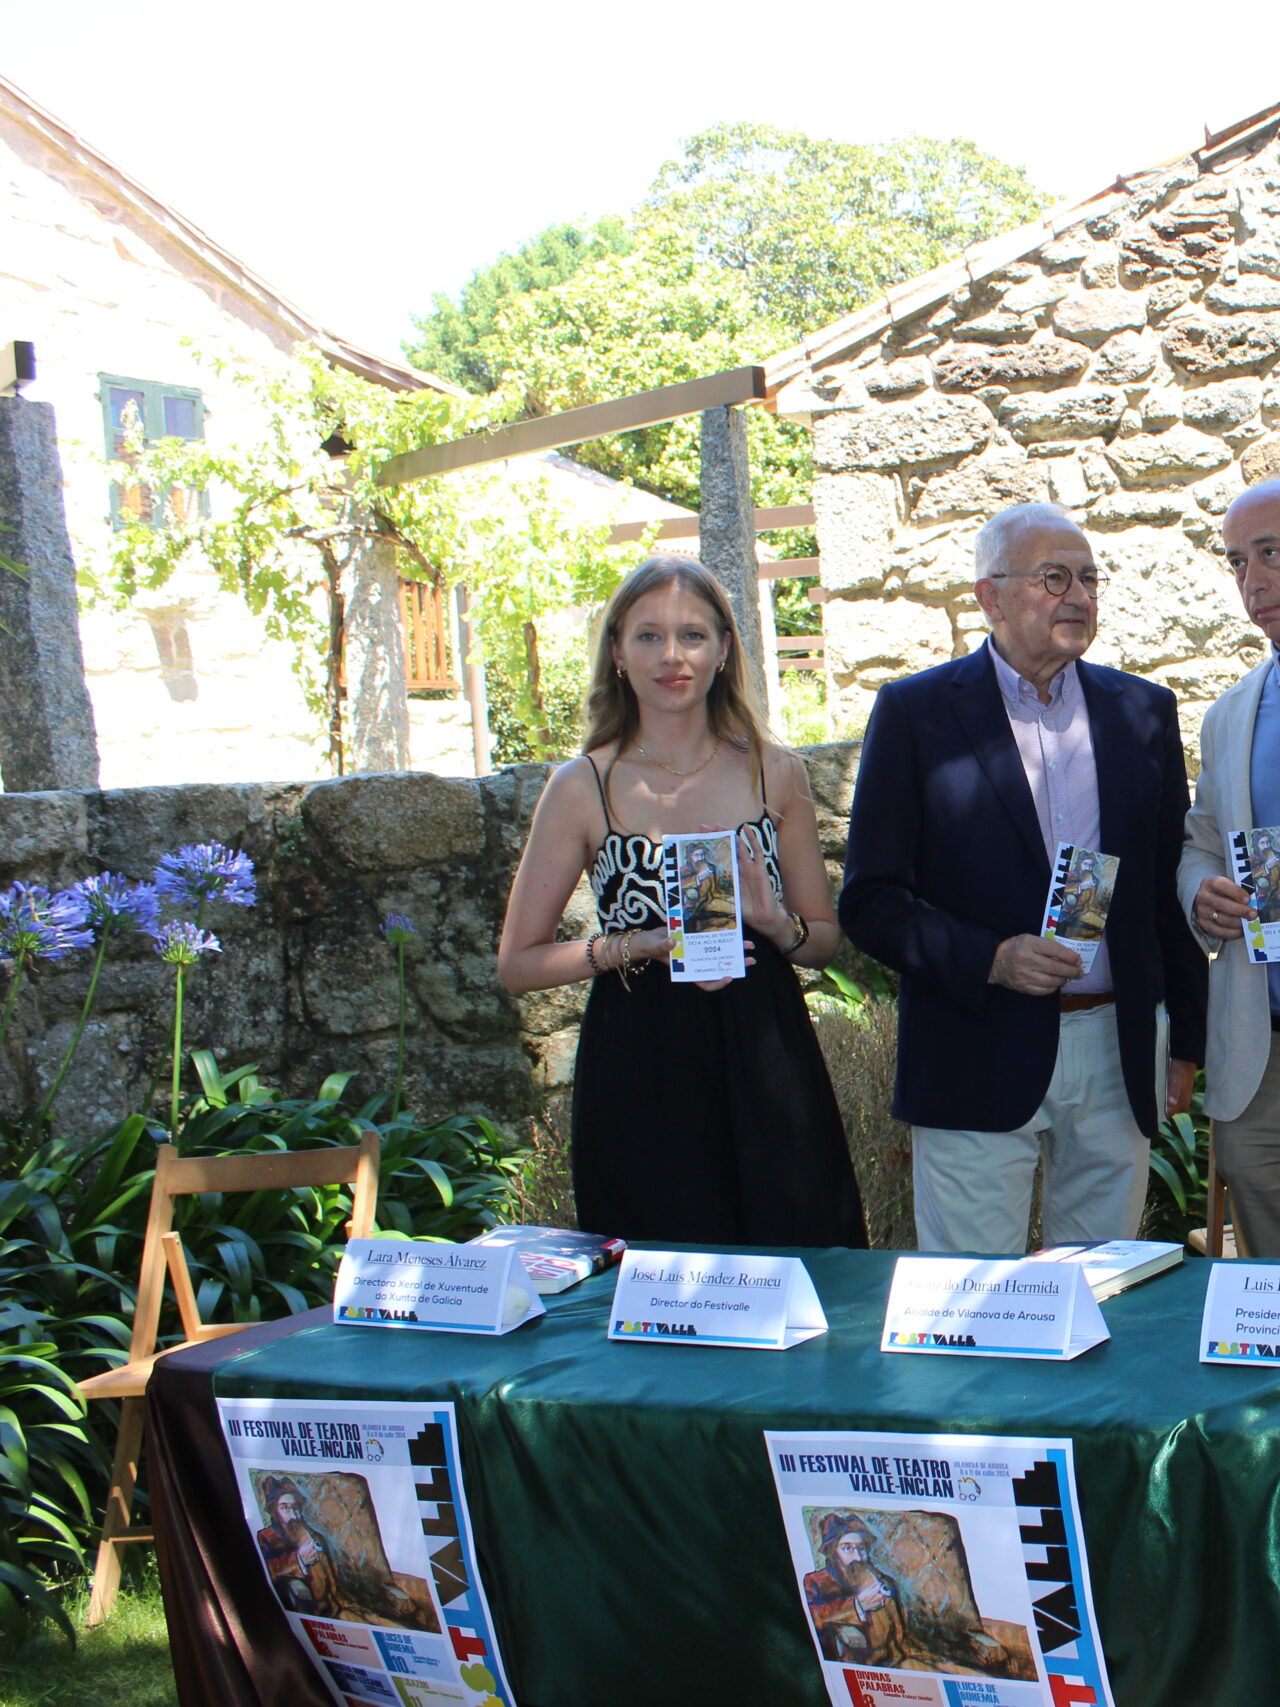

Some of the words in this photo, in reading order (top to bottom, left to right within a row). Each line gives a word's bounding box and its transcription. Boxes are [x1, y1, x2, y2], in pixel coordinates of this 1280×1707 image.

[1044, 845, 1074, 940] STIVALLE
[1233, 831, 1268, 961] FESIVALLE
[664, 842, 685, 973] FESTIVALLE
[704, 946, 721, 954] 2024
[367, 1249, 393, 1263] Lara
[394, 1251, 444, 1266] Meneses
[445, 1252, 487, 1269] Álvarez
[353, 1276, 396, 1288] Directora
[398, 1279, 423, 1290] Xeral
[425, 1281, 436, 1291] de
[438, 1282, 489, 1294] Xuventude
[630, 1267, 656, 1281] José
[687, 1270, 736, 1285] Méndez
[738, 1272, 782, 1288] Romeu
[1244, 1276, 1274, 1291] Luis
[962, 1278, 1001, 1293] Durán
[1004, 1279, 1060, 1294] Hermida
[375, 1291, 387, 1300] da
[390, 1292, 417, 1303] Xunta
[418, 1294, 430, 1303] de
[432, 1294, 463, 1305] Galicia
[650, 1297, 689, 1308] Director
[690, 1299, 703, 1309] do
[704, 1300, 750, 1312] Festivalle
[339, 1305, 419, 1322] FESTIVALLE
[904, 1306, 941, 1318] Alcalde
[942, 1308, 955, 1318] de
[957, 1308, 1001, 1320] Vilanova
[1002, 1310, 1016, 1320] de
[1017, 1311, 1056, 1322] Arousa
[615, 1320, 697, 1336] FESTIVALLE
[889, 1332, 976, 1347] FESTIVALLE
[228, 1419, 242, 1437] III
[243, 1420, 297, 1439] FESTIVAL
[298, 1422, 315, 1440] DE
[315, 1422, 361, 1441] TEATRO
[281, 1439, 364, 1459] VALLE-INCLAN
[779, 1454, 797, 1472] III
[799, 1454, 870, 1475] FESTIVAL
[871, 1456, 890, 1476] DE
[893, 1457, 951, 1479] TEATRO
[848, 1473, 955, 1498] VALLE-INCLAN
[856, 1670, 891, 1682] DIVINAS
[860, 1681, 905, 1694] PALABRAS
[957, 1681, 984, 1692] LUCES
[985, 1684, 997, 1693] DE
[960, 1691, 1000, 1704] BOHEMIA
